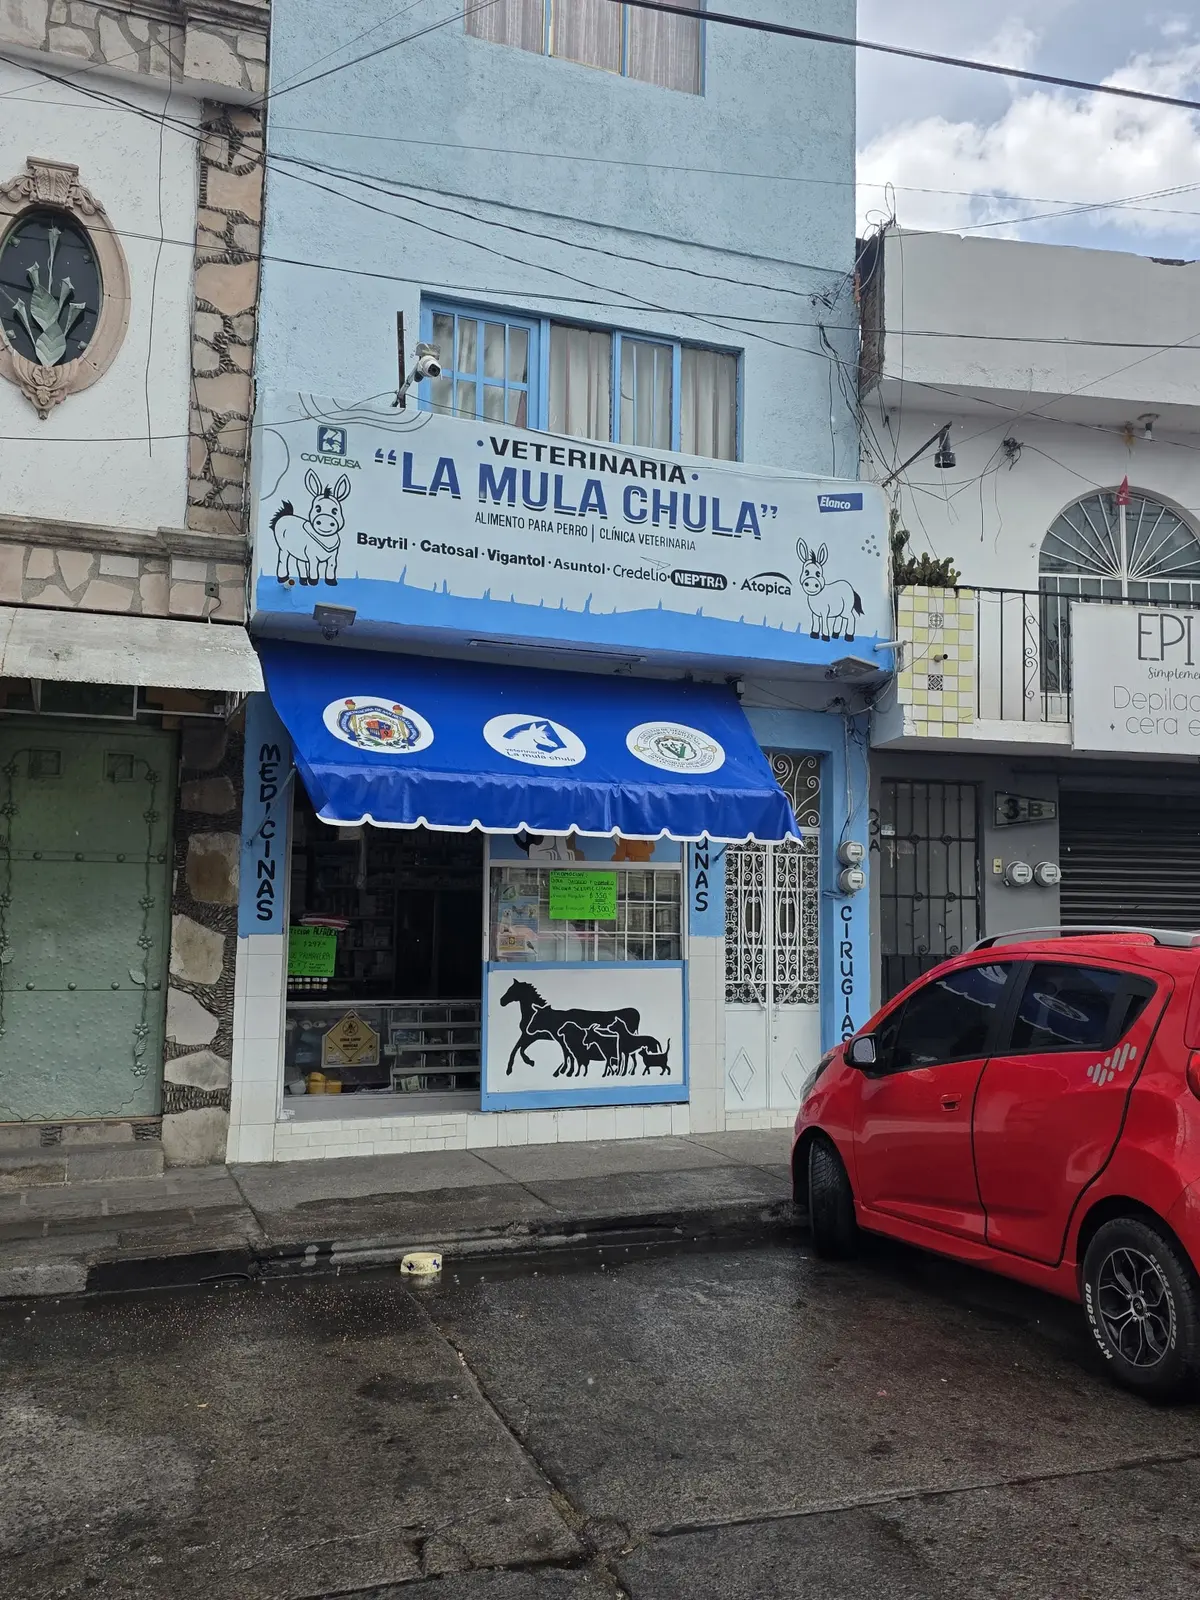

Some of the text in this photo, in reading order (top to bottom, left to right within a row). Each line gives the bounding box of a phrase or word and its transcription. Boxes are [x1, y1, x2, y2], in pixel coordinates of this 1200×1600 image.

[300, 452, 362, 470] COVEGUSA
[489, 436, 687, 485] VETERINARIA
[478, 463, 608, 519] MULA
[819, 496, 851, 510] Elanco
[475, 511, 696, 551] ALIMENTO PARA PERRO CLÍNICA VETERINARIA
[357, 532, 792, 596] Baytril Catosal Vigantol Asuntol Credelio NEPTRA Atopica
[1137, 612, 1195, 666] EPI
[1126, 717, 1178, 735] cera
[255, 743, 281, 921] MEDICINAS
